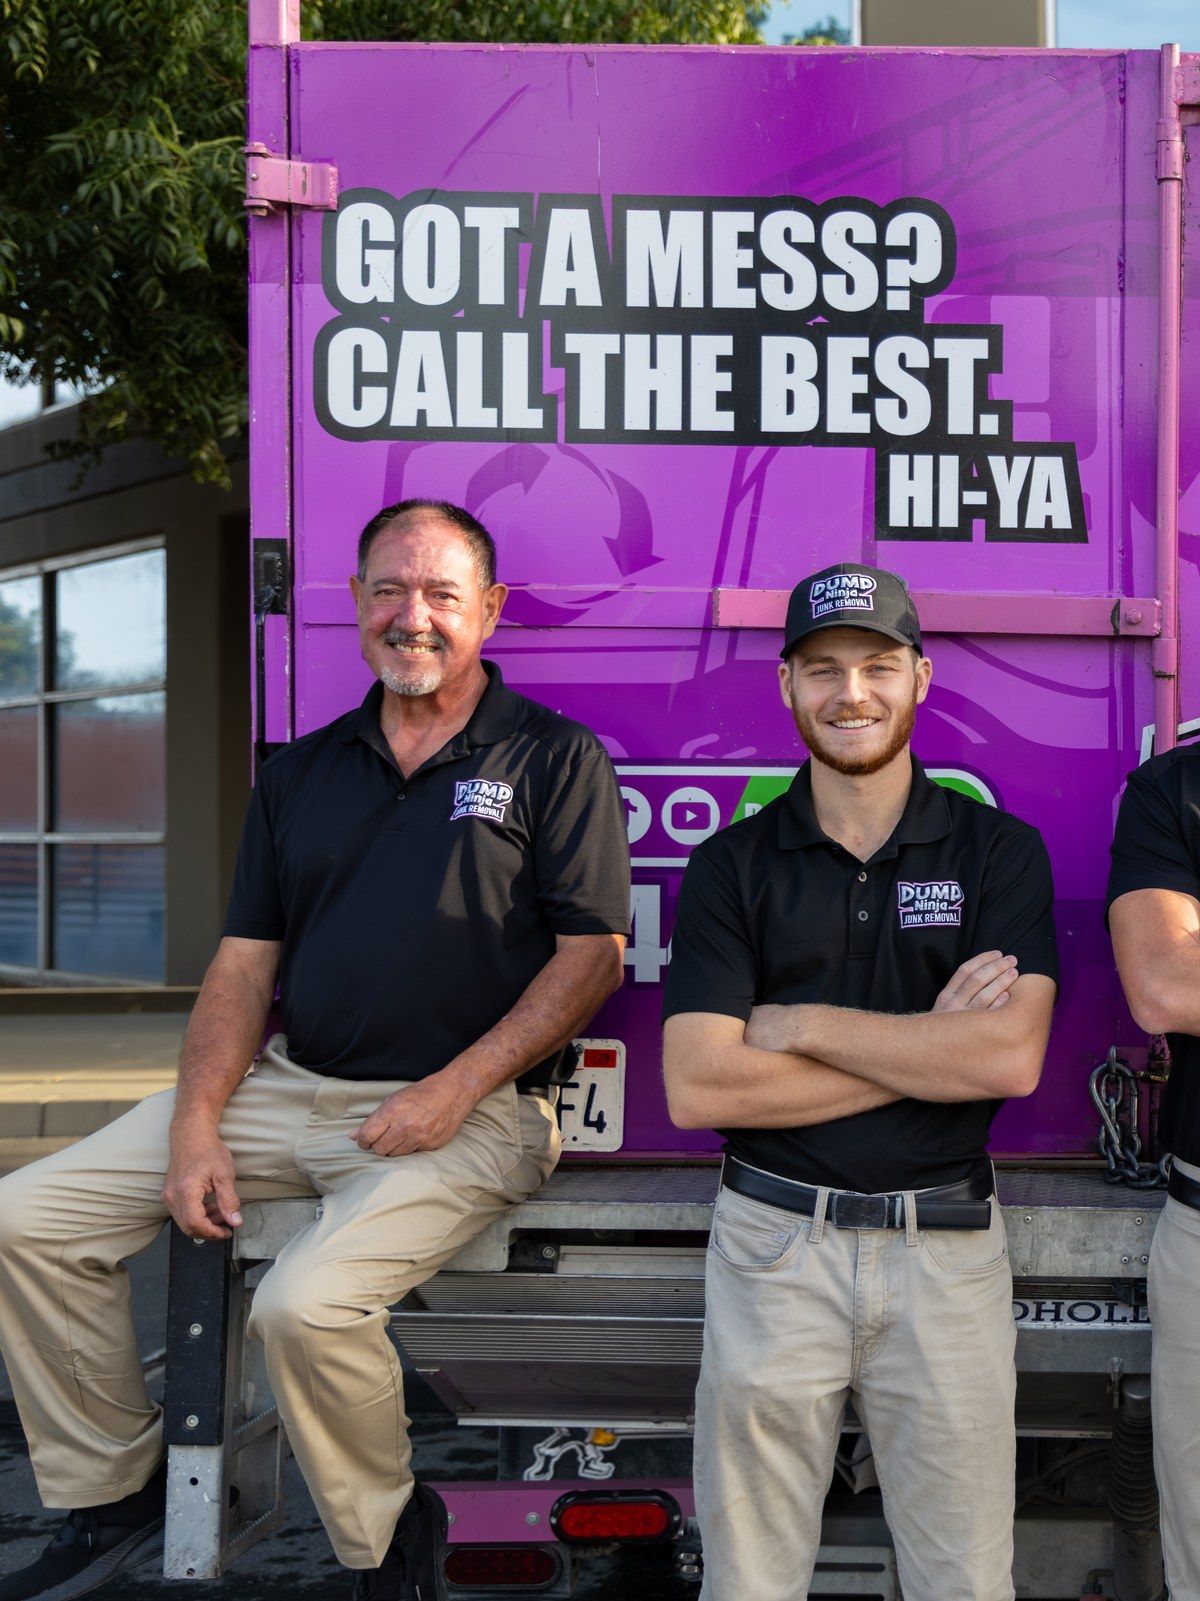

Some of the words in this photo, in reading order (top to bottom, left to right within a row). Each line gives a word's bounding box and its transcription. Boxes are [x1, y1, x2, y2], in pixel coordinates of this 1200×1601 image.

[335, 202, 520, 306] GOT
[540, 208, 602, 307] A
[629, 209, 943, 312] MESS?
[326, 327, 543, 429] CALL
[564, 332, 735, 431] THE
[760, 334, 999, 435] BEST.
[889, 454, 1073, 530] HI-YA
[813, 576, 873, 597] DUMP
[825, 587, 858, 600] Ninja
[816, 601, 834, 615] JUNK
[835, 598, 870, 608] REMOVAL
[457, 782, 511, 801] DUMP
[468, 804, 501, 819] REMOVAL
[900, 884, 962, 904] DUMP
[914, 899, 948, 913] Ninja
[903, 913, 923, 925] JUNK
[924, 912, 960, 923] REMOVAL
